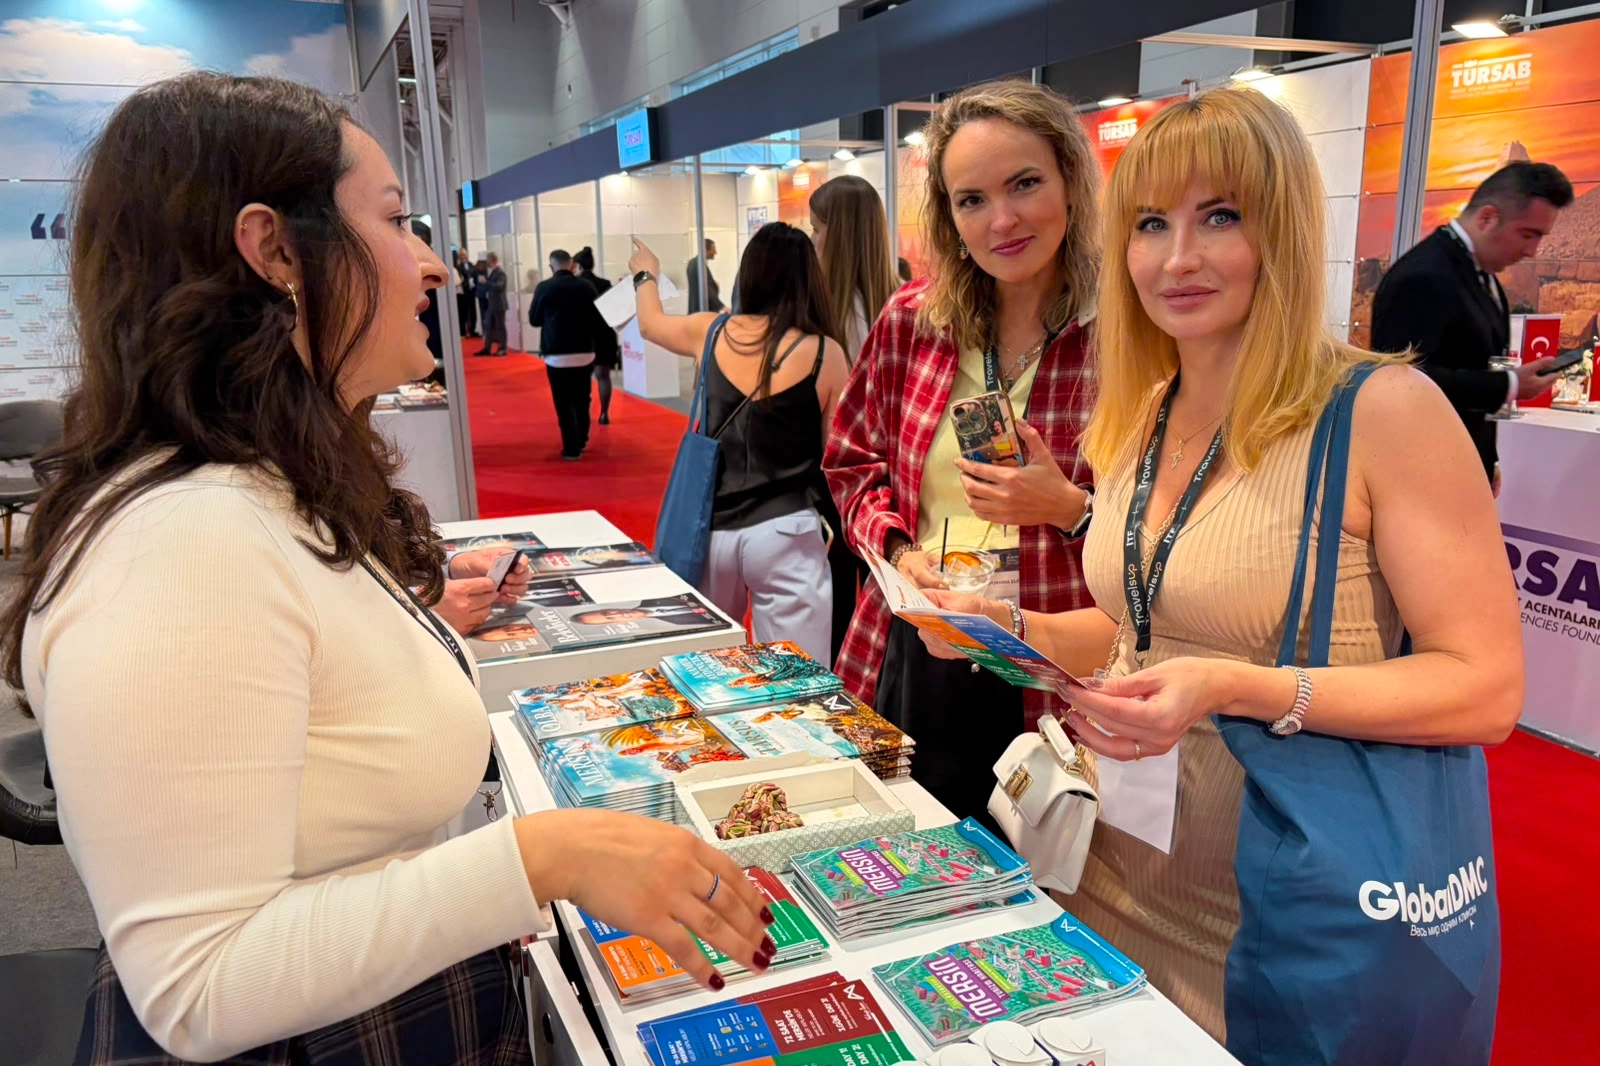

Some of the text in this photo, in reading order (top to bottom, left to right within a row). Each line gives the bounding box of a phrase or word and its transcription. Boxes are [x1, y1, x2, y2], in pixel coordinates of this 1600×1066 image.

[1451, 59, 1532, 88] TÜRSAB
[1126, 530, 1135, 547] ITF
[1163, 527, 1176, 544] ITF
[531, 705, 561, 732] OLBA
[728, 719, 778, 756] TARSUS
[1359, 855, 1488, 924] GlobalDMC
[1410, 924, 1428, 937] Весь
[1428, 924, 1441, 937] мир
